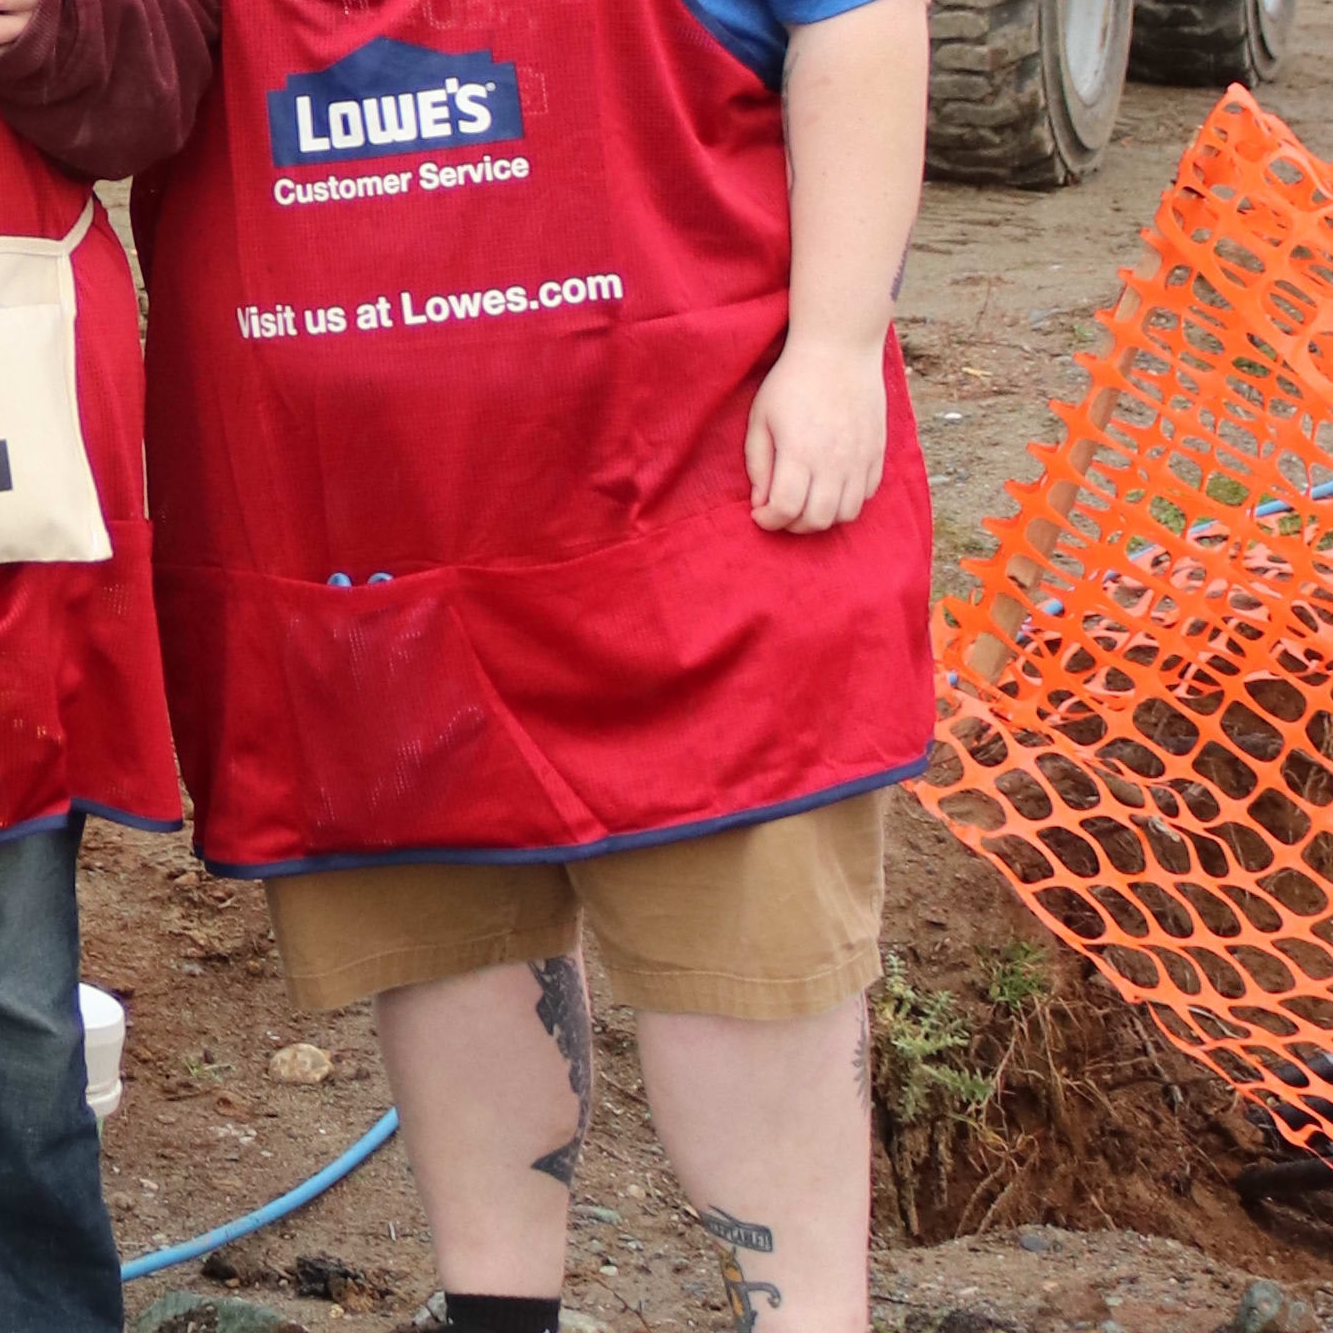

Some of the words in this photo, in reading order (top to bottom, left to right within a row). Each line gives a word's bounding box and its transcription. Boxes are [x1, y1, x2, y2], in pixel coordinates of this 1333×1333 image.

[295, 77, 495, 155] LOWE'S
[273, 169, 413, 207] Customer
[419, 154, 531, 191] Service
[236, 304, 297, 340] Visit
[305, 306, 347, 335] us
[356, 296, 393, 331] at
[400, 272, 624, 327] Lowes.com
